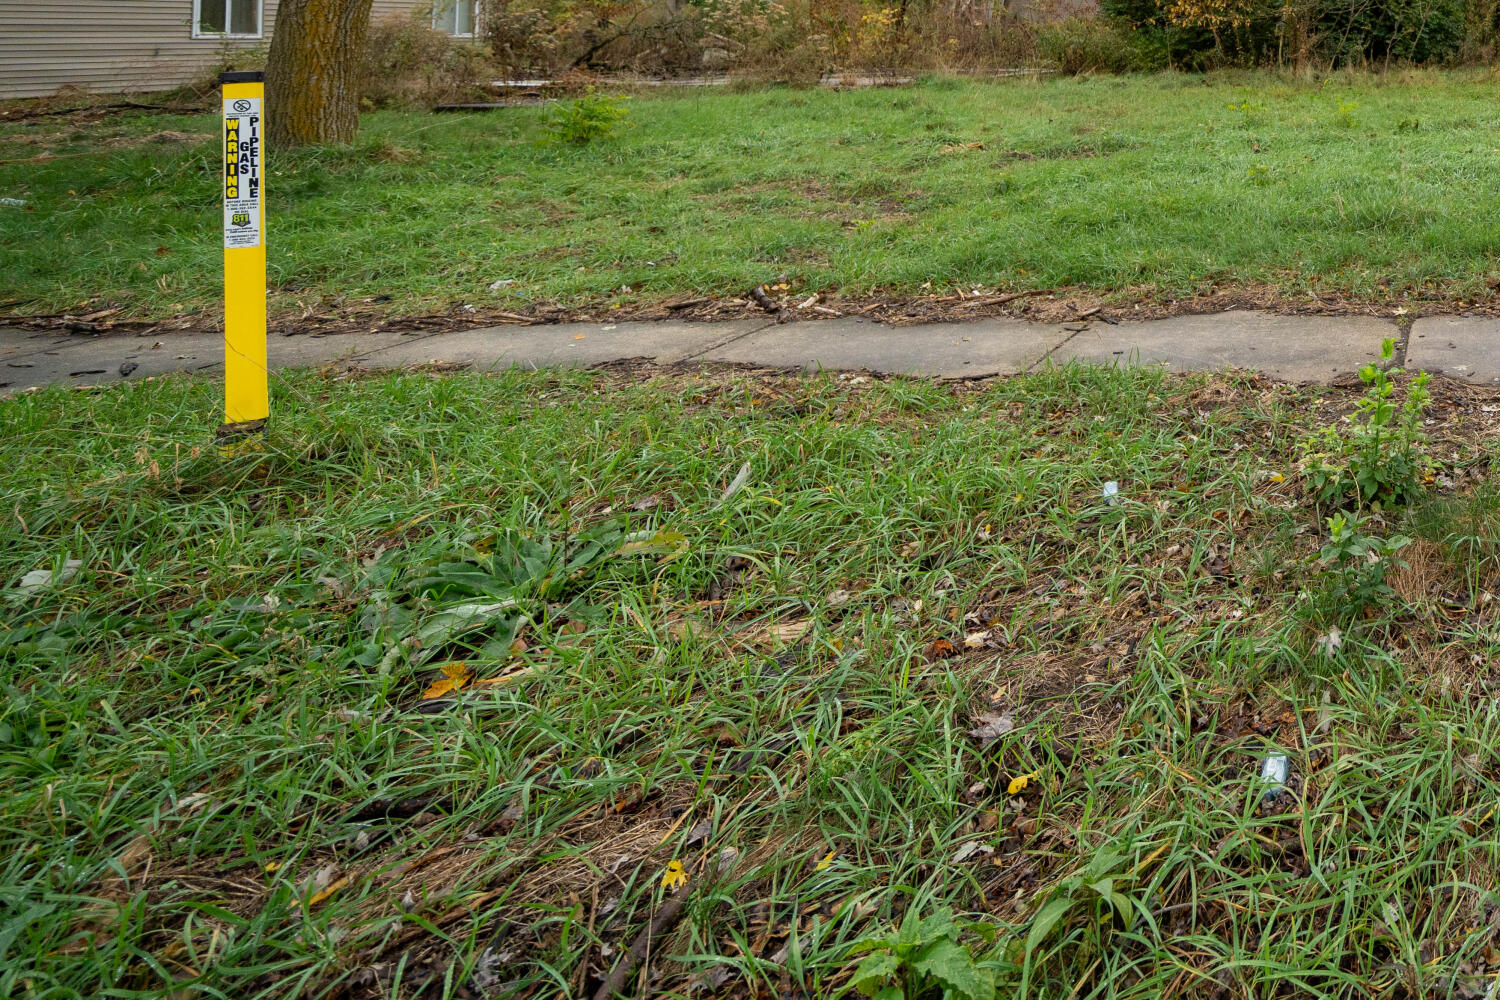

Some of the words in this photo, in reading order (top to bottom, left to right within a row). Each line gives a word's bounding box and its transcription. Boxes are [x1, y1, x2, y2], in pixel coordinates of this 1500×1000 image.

[226, 119, 239, 198] WARNING
[240, 142, 249, 174] GAS
[249, 117, 259, 198] PIPELINE
[233, 214, 248, 223] 811
